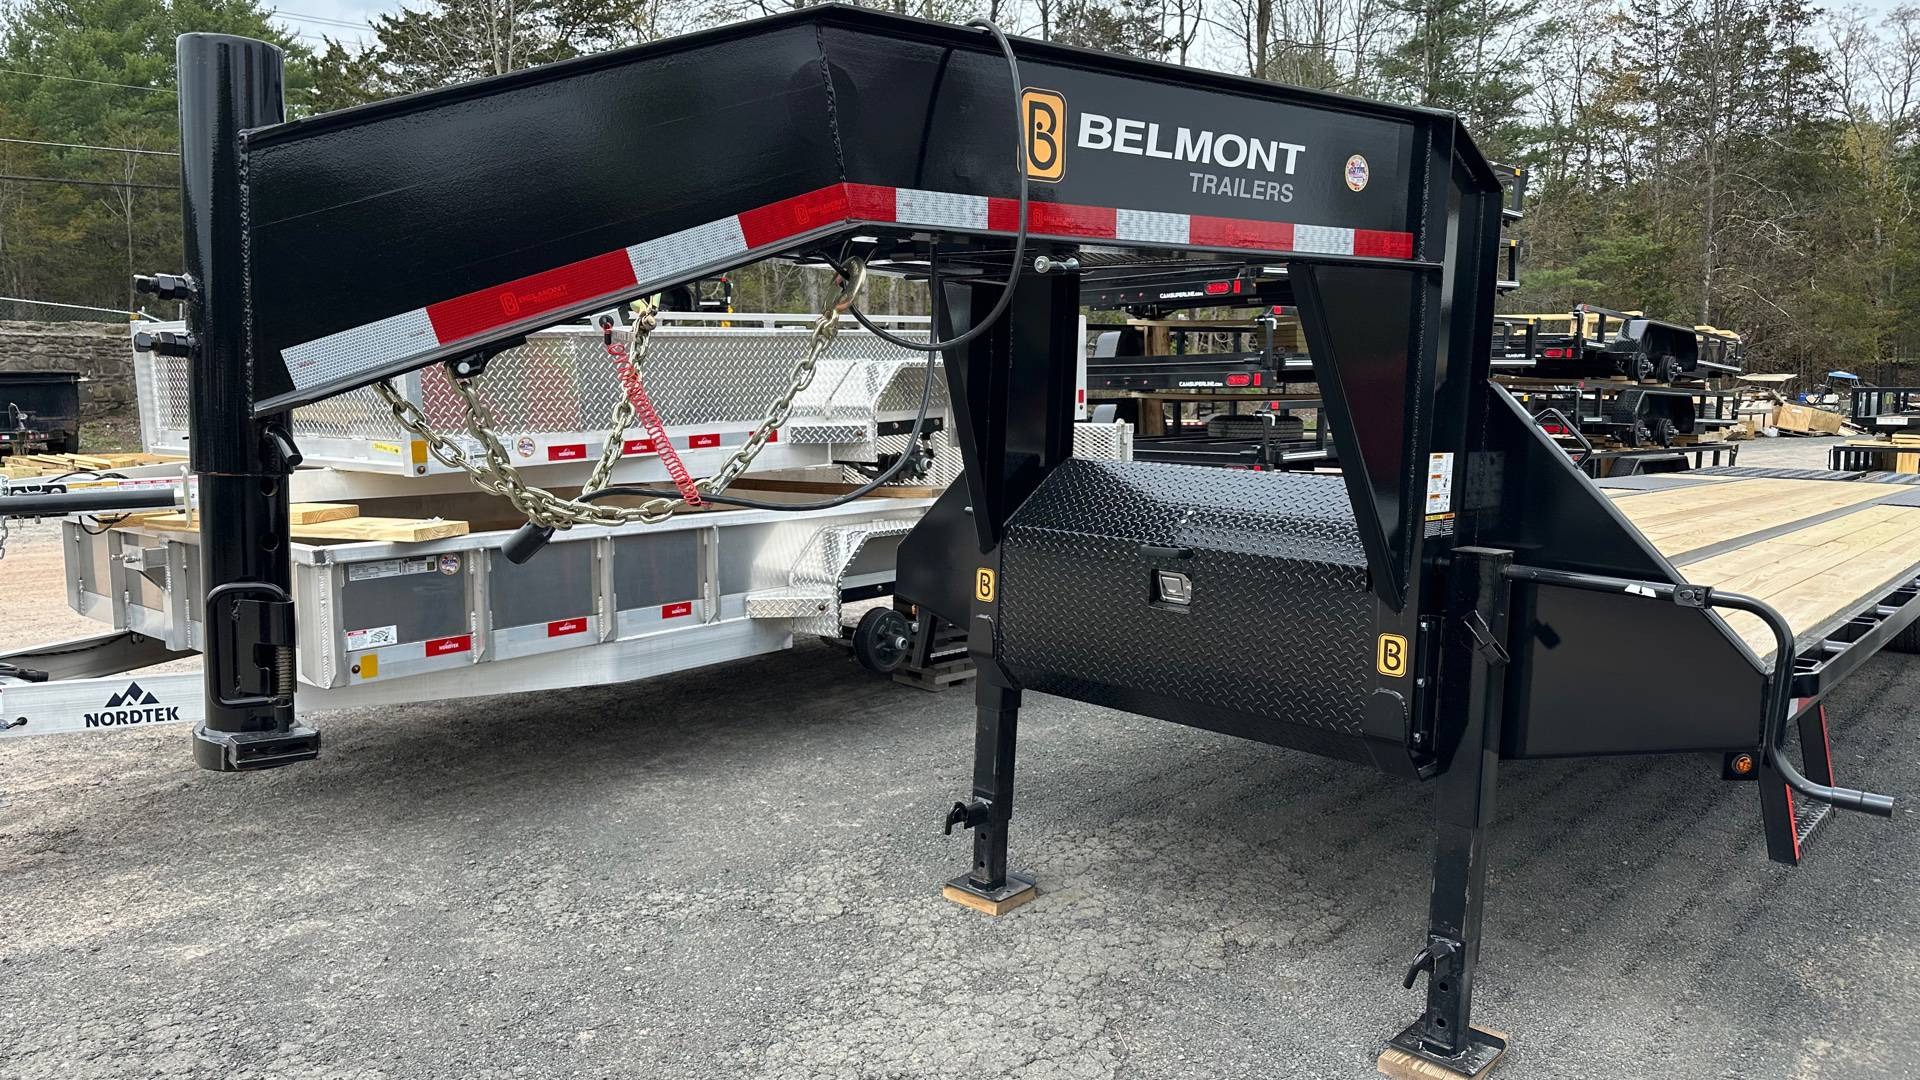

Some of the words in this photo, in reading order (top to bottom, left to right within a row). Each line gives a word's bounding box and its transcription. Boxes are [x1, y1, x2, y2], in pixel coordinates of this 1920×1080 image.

[1028, 100, 1057, 170] B
[1077, 112, 1306, 175] BELMONT
[1189, 172, 1294, 203] TRAILERS
[980, 572, 991, 597] B
[1384, 639, 1401, 671] B
[83, 706, 180, 728] NORDTEK
